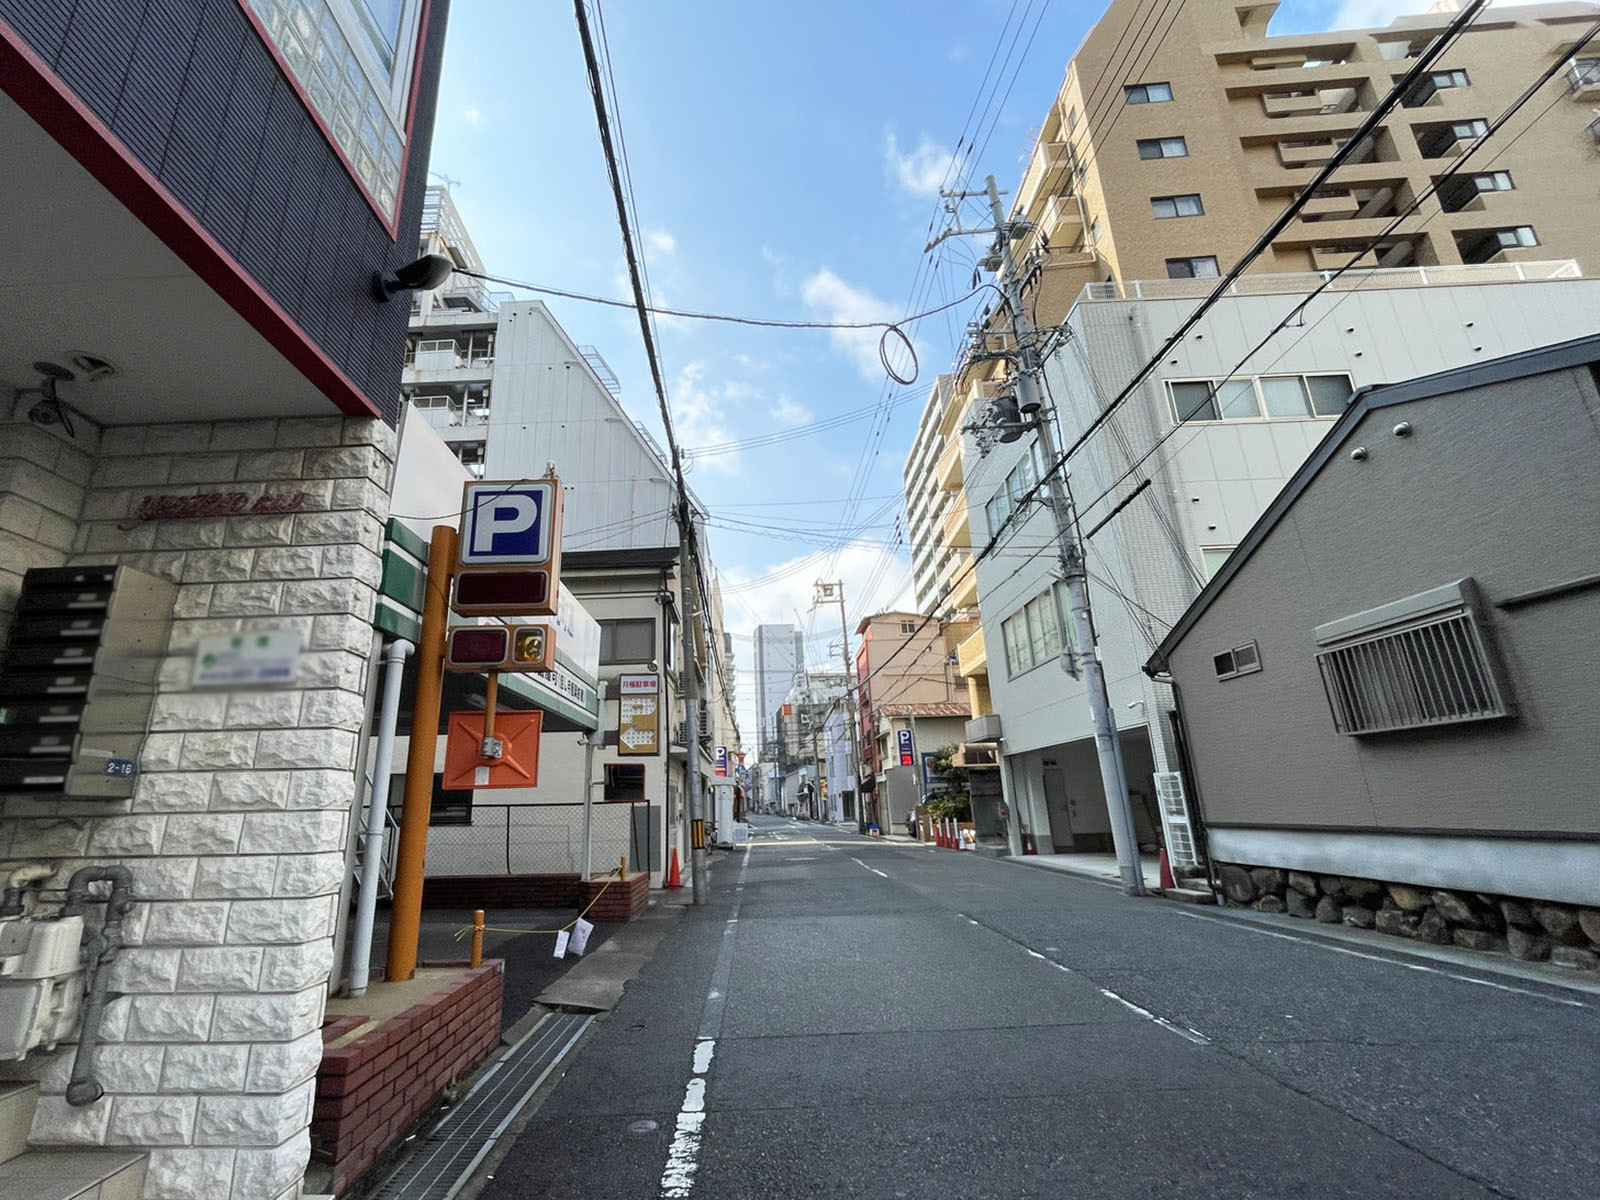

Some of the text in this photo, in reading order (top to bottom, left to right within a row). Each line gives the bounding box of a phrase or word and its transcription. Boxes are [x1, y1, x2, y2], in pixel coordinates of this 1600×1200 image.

[473, 494, 538, 552] P
[900, 731, 910, 744] P
[715, 747, 725, 760] P
